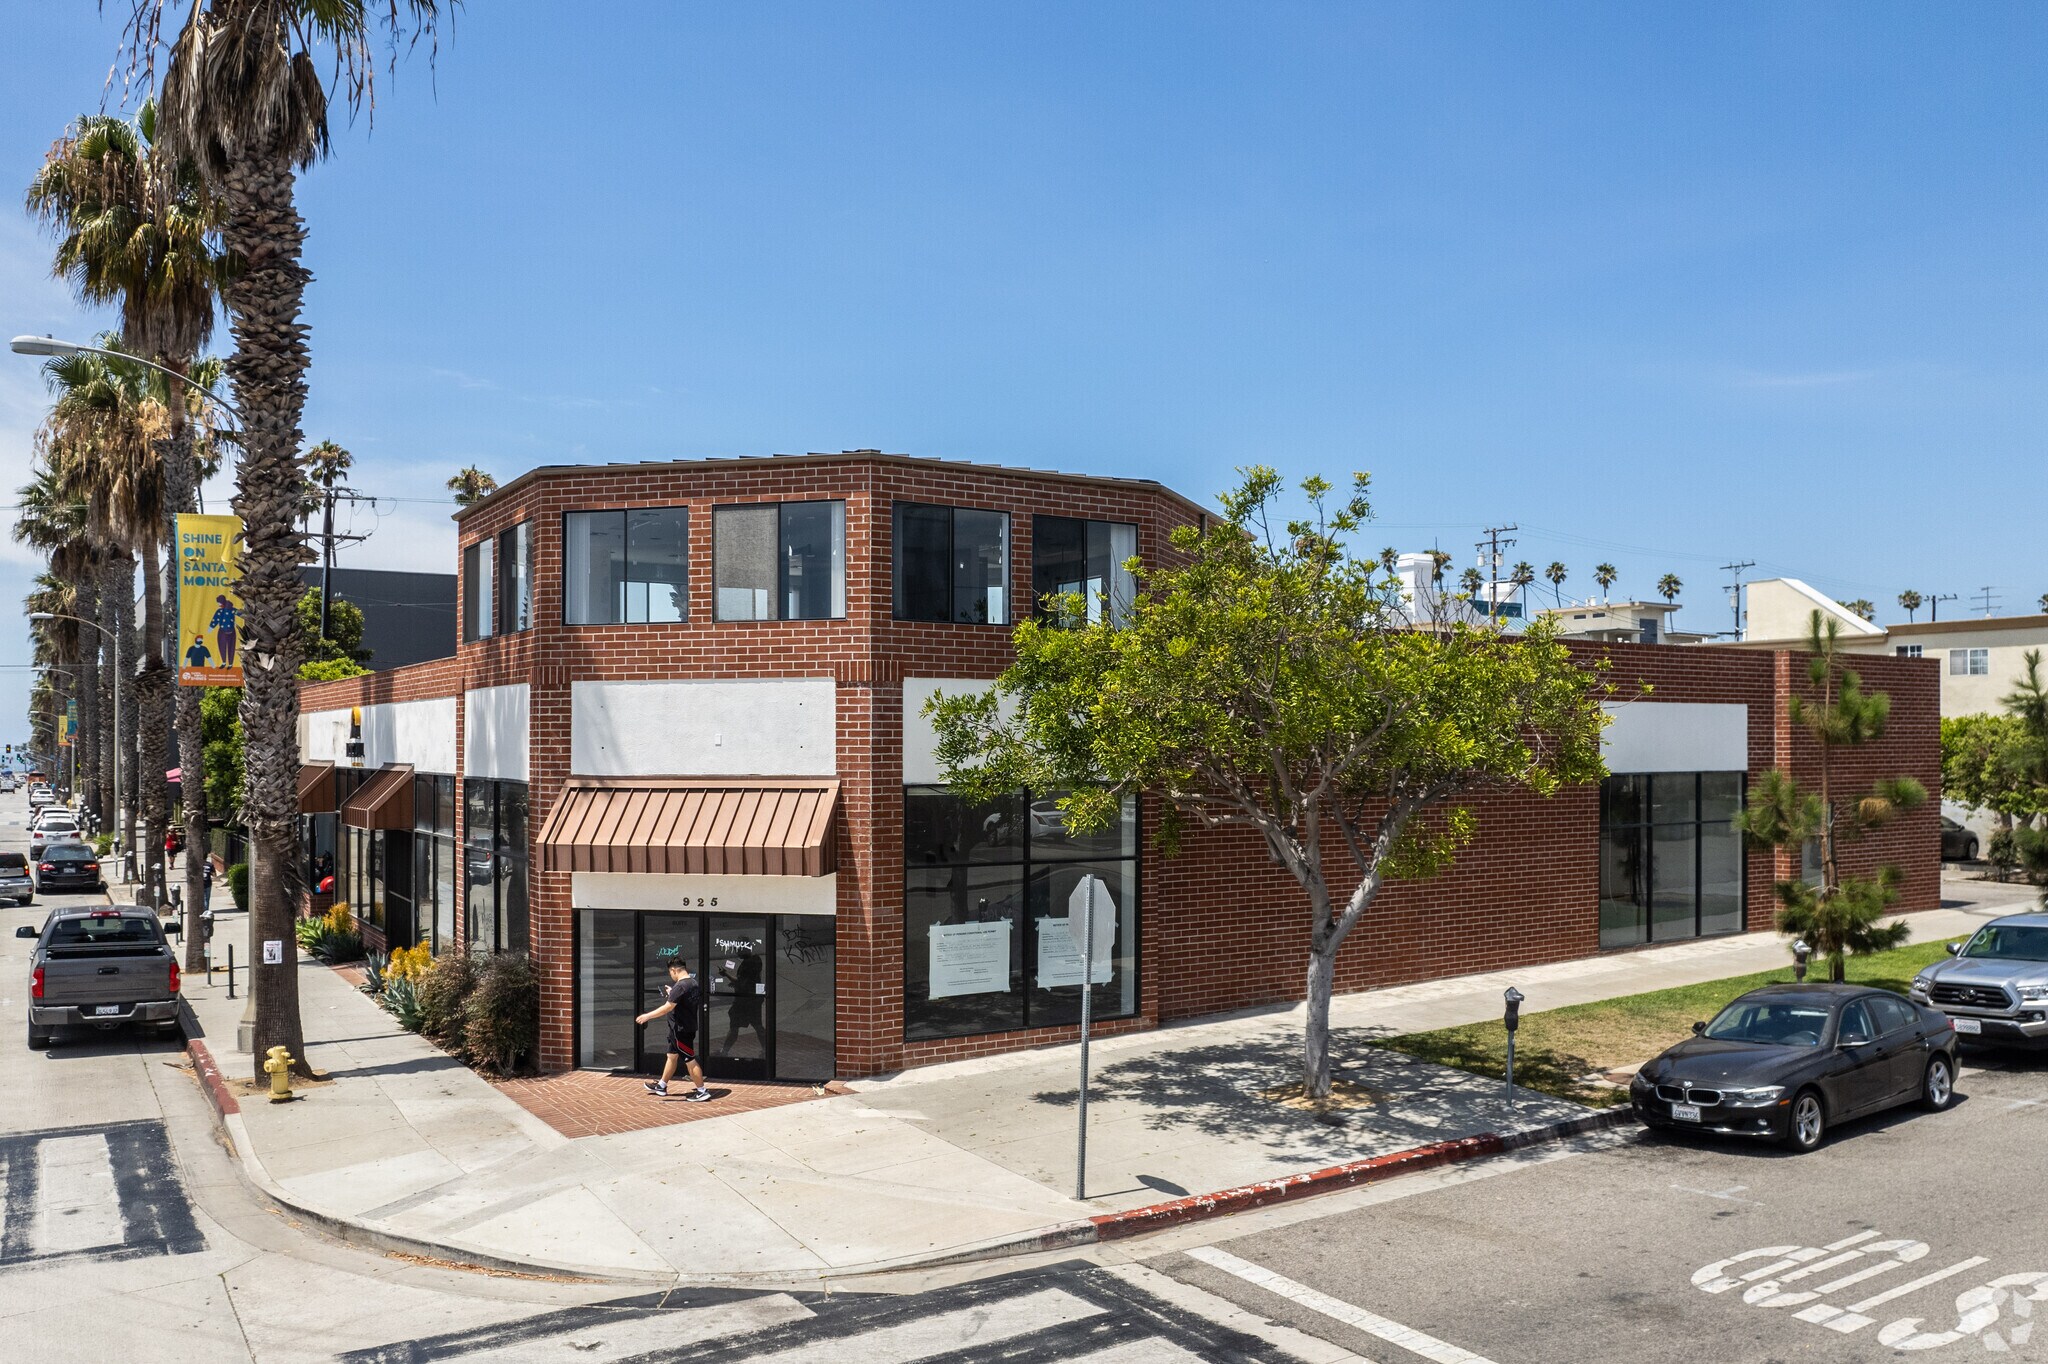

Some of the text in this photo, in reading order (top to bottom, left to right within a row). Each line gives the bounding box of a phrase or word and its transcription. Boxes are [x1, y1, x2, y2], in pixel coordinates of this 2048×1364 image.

[182, 533, 222, 545] SHINE
[183, 547, 206, 558] ON
[183, 561, 227, 574] SANTA
[183, 575, 235, 587] MONIC
[1691, 1229, 2048, 1351] STOP
